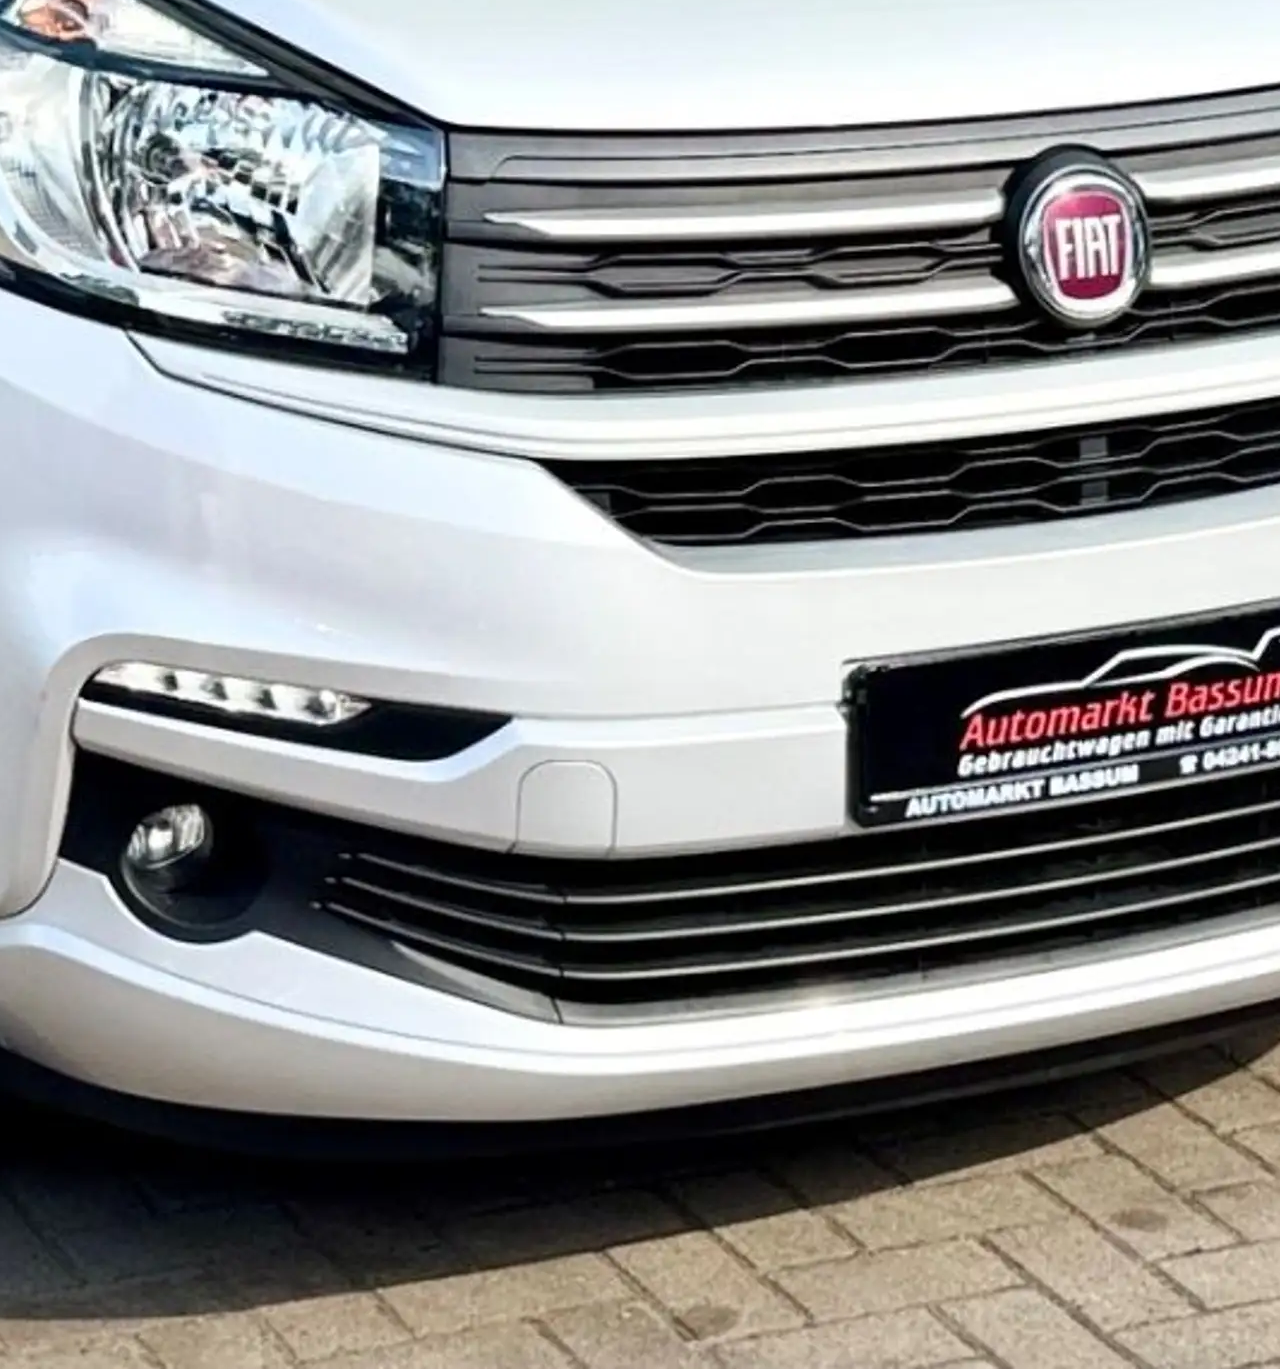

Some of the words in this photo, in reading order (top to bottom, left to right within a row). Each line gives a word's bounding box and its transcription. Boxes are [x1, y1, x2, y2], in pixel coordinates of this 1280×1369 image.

[1055, 214, 1121, 281] FIAT
[957, 729, 1151, 778] Gebrauchtwagen
[1155, 719, 1194, 746] mit
[959, 689, 1156, 751] Automarkt
[905, 778, 1045, 819] AUTOMARKT
[1049, 763, 1139, 796] BASSUM
